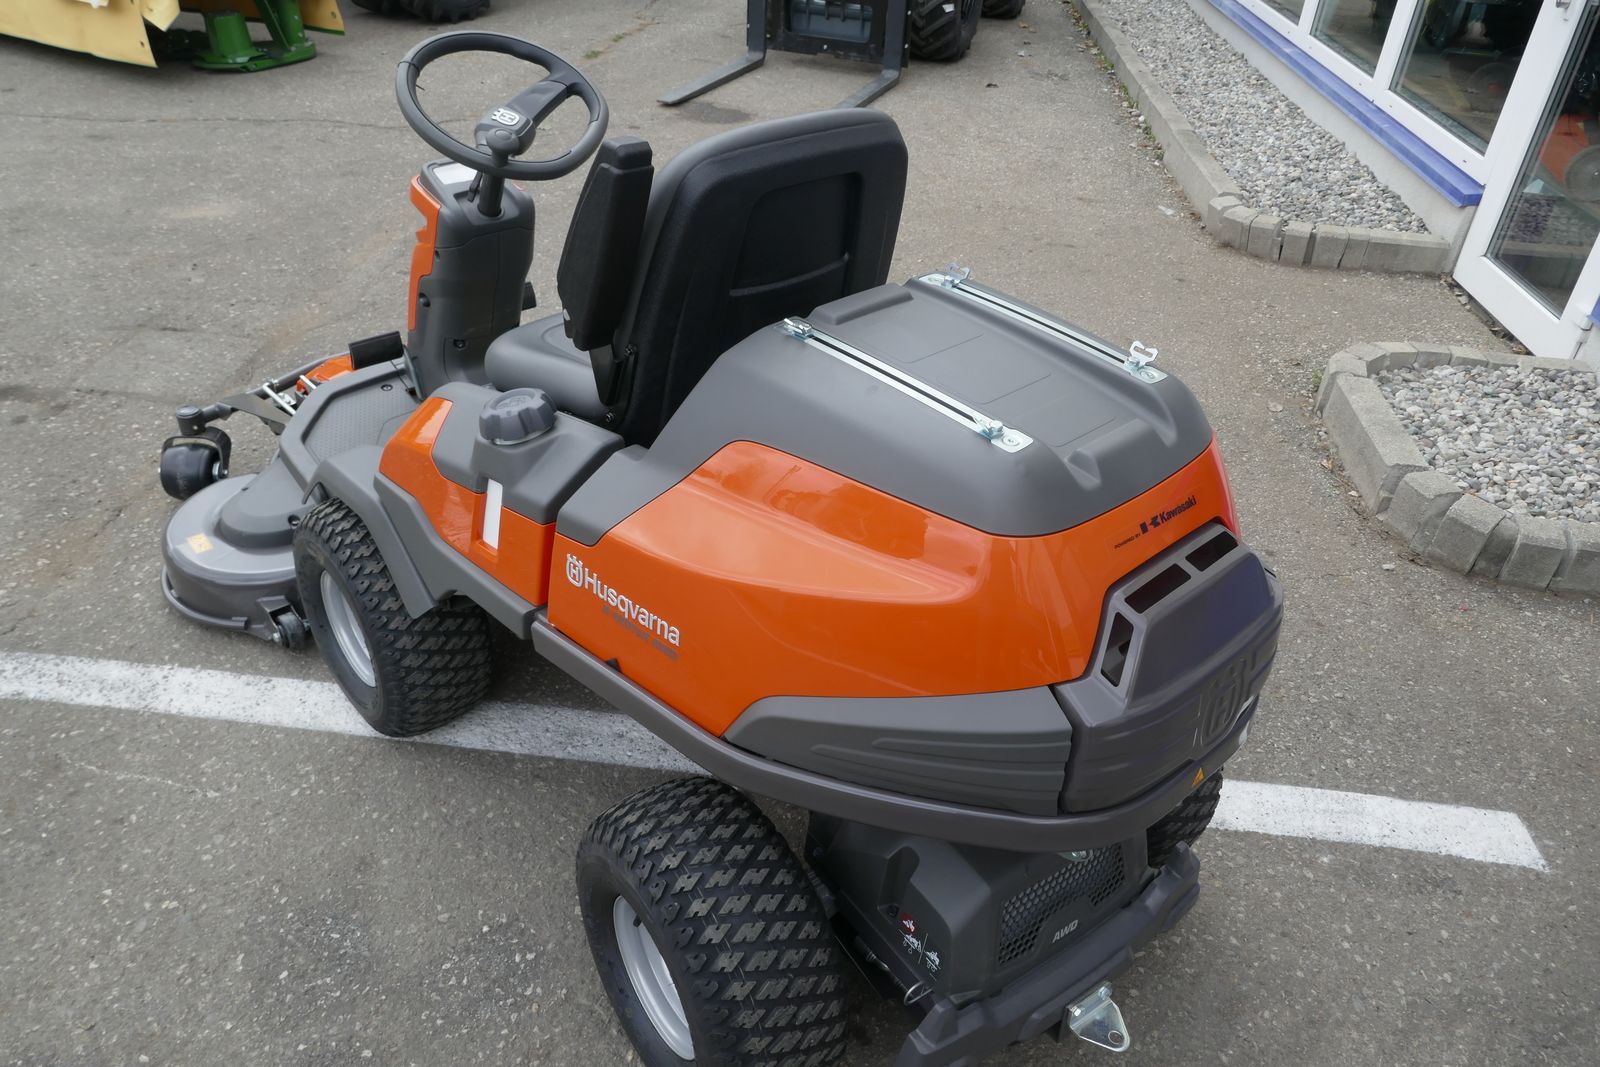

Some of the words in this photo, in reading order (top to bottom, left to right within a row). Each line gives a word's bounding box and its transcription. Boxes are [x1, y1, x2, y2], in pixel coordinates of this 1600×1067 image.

[1159, 495, 1197, 524] Kawasaki
[584, 568, 681, 647] Husqvarna
[1052, 919, 1079, 943] AWD
